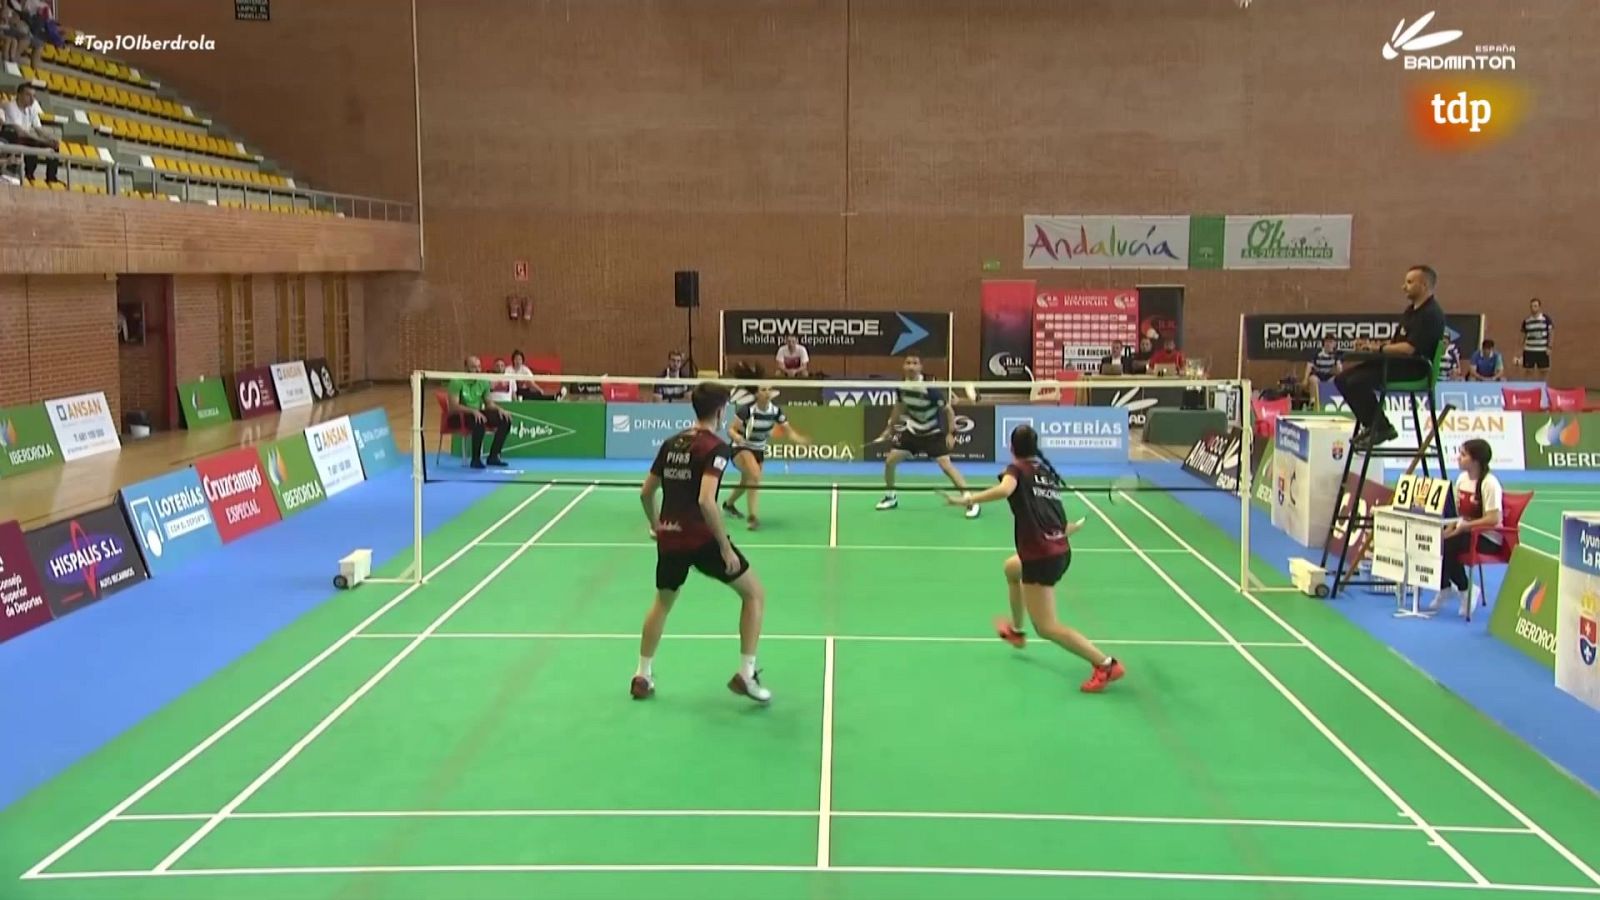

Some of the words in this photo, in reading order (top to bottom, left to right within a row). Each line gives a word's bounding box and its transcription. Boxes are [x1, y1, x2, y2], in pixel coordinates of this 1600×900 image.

[1029, 225, 1180, 260] Andalucía
[743, 334, 776, 345] bebida
[801, 334, 855, 345] deportistas
[1264, 338, 1298, 349] bebida
[1300, 340, 1322, 350] para
[67, 399, 103, 421] ANSAN
[634, 419, 672, 429] DENTAL
[1040, 420, 1122, 435] LOTERÍAS
[1424, 416, 1504, 432] ANSAN
[9, 443, 54, 466] IBERDROLA
[203, 464, 262, 503] Cruzcampo
[155, 486, 204, 518] LOTERÍAS
[282, 480, 323, 510] IBERDROLA
[1398, 480, 1410, 505] 3
[1430, 485, 1443, 511] 4
[226, 499, 260, 525] ESPECIAL
[50, 544, 102, 578] HISPALIS
[103, 538, 122, 559] S.L.
[1583, 547, 1593, 566] La
[6, 606, 16, 618] de
[15, 596, 43, 615] Deportes
